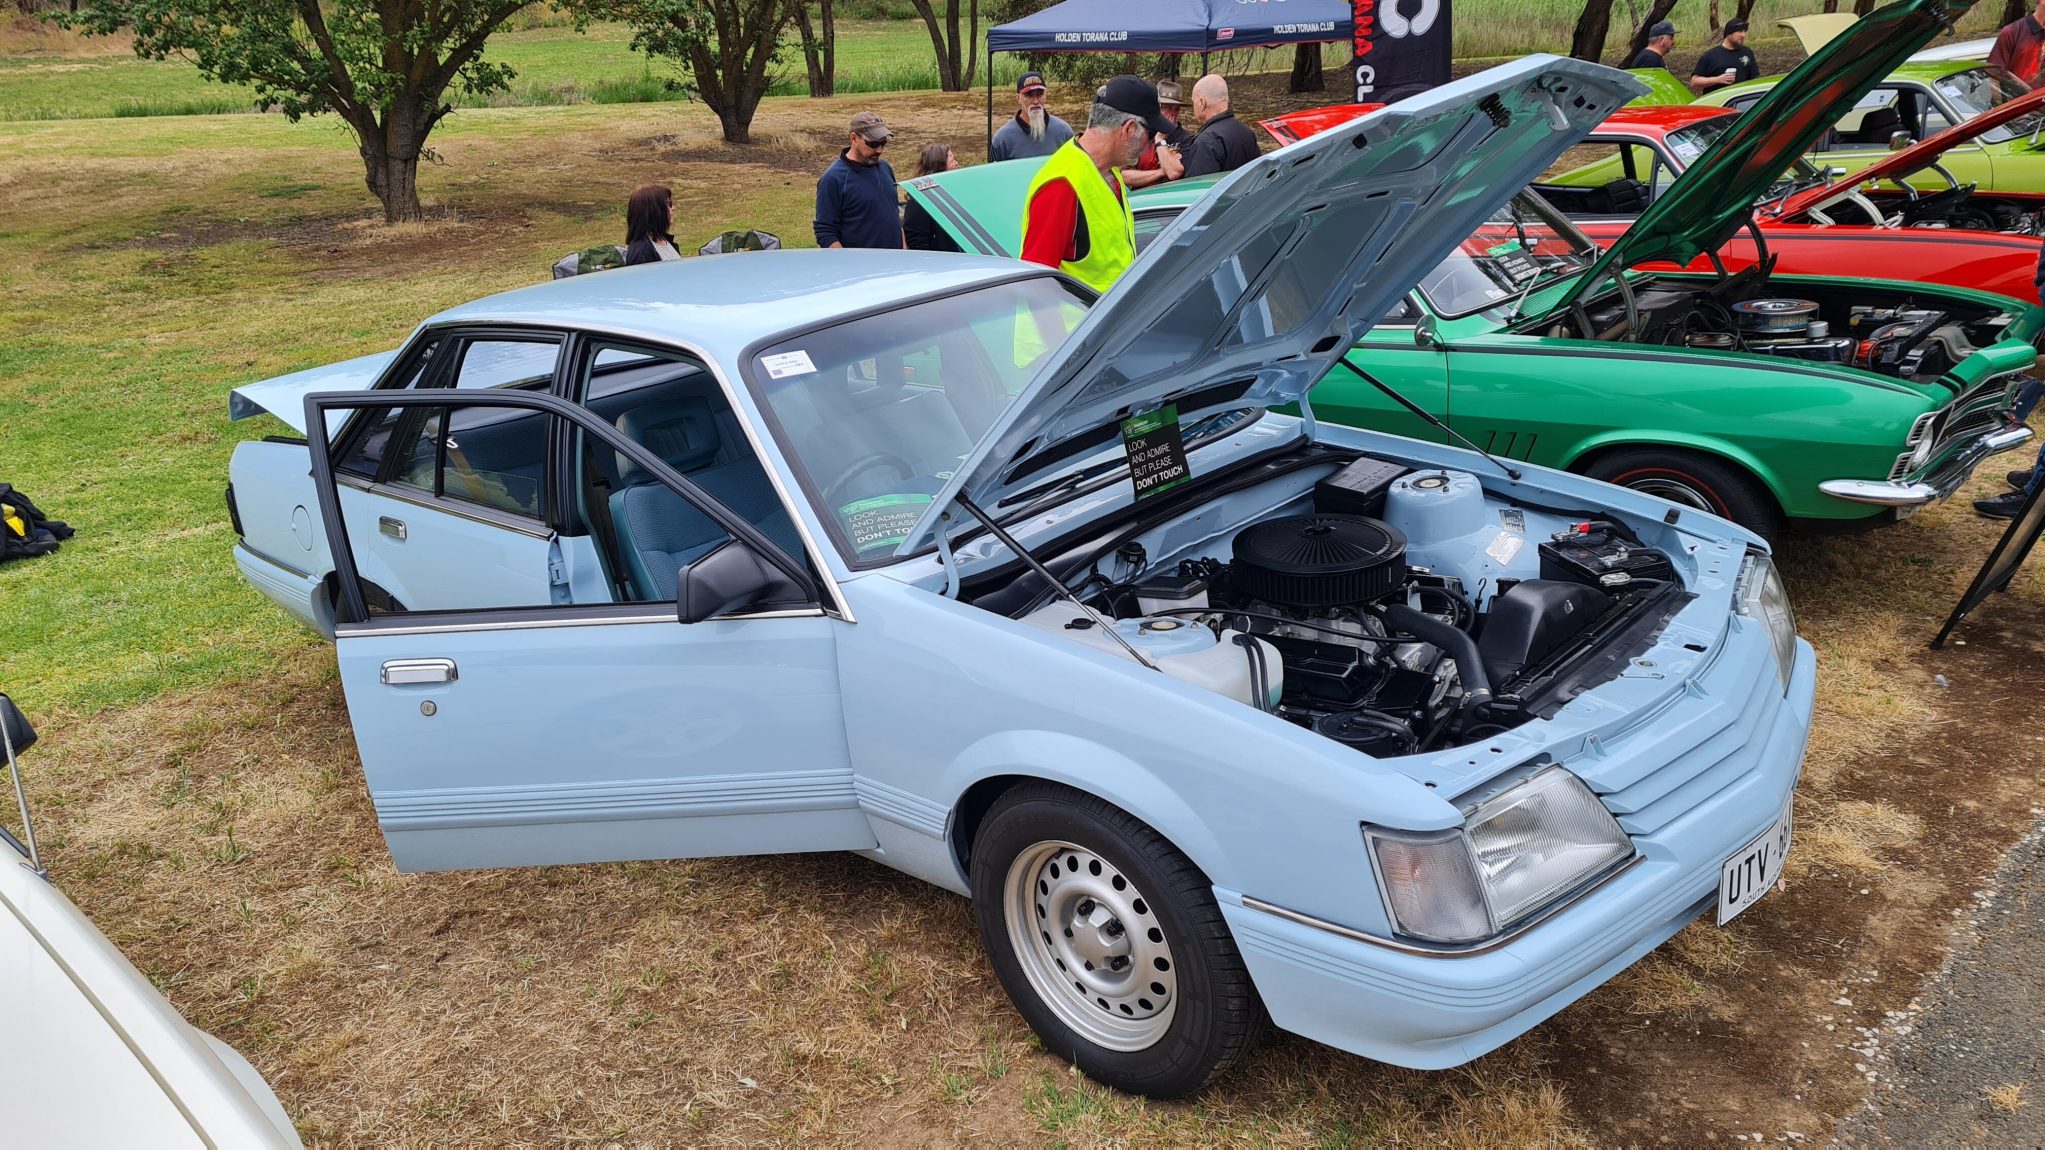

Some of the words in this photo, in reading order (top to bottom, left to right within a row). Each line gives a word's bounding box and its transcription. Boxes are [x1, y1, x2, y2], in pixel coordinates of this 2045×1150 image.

[1273, 25, 1297, 34] HOLDEN
[1297, 23, 1319, 33] TORANA
[1319, 22, 1335, 31] CLUB
[1055, 33, 1081, 42] HOLDEN
[1082, 32, 1108, 42] TORANA
[1109, 31, 1127, 41] CLUB
[1128, 438, 1148, 452] LOOK
[1131, 453, 1146, 465] AND
[1146, 442, 1171, 458] ADMIRE
[1134, 464, 1148, 477] BUT
[1148, 455, 1173, 472] PLEASE
[1136, 474, 1159, 490] DON'T
[1158, 464, 1184, 480] TOUCH
[848, 510, 878, 522] LOOK
[851, 518, 874, 529] AND
[877, 512, 918, 522] ADMIRE
[853, 526, 875, 537] BUT
[856, 529, 892, 544] DON'T
